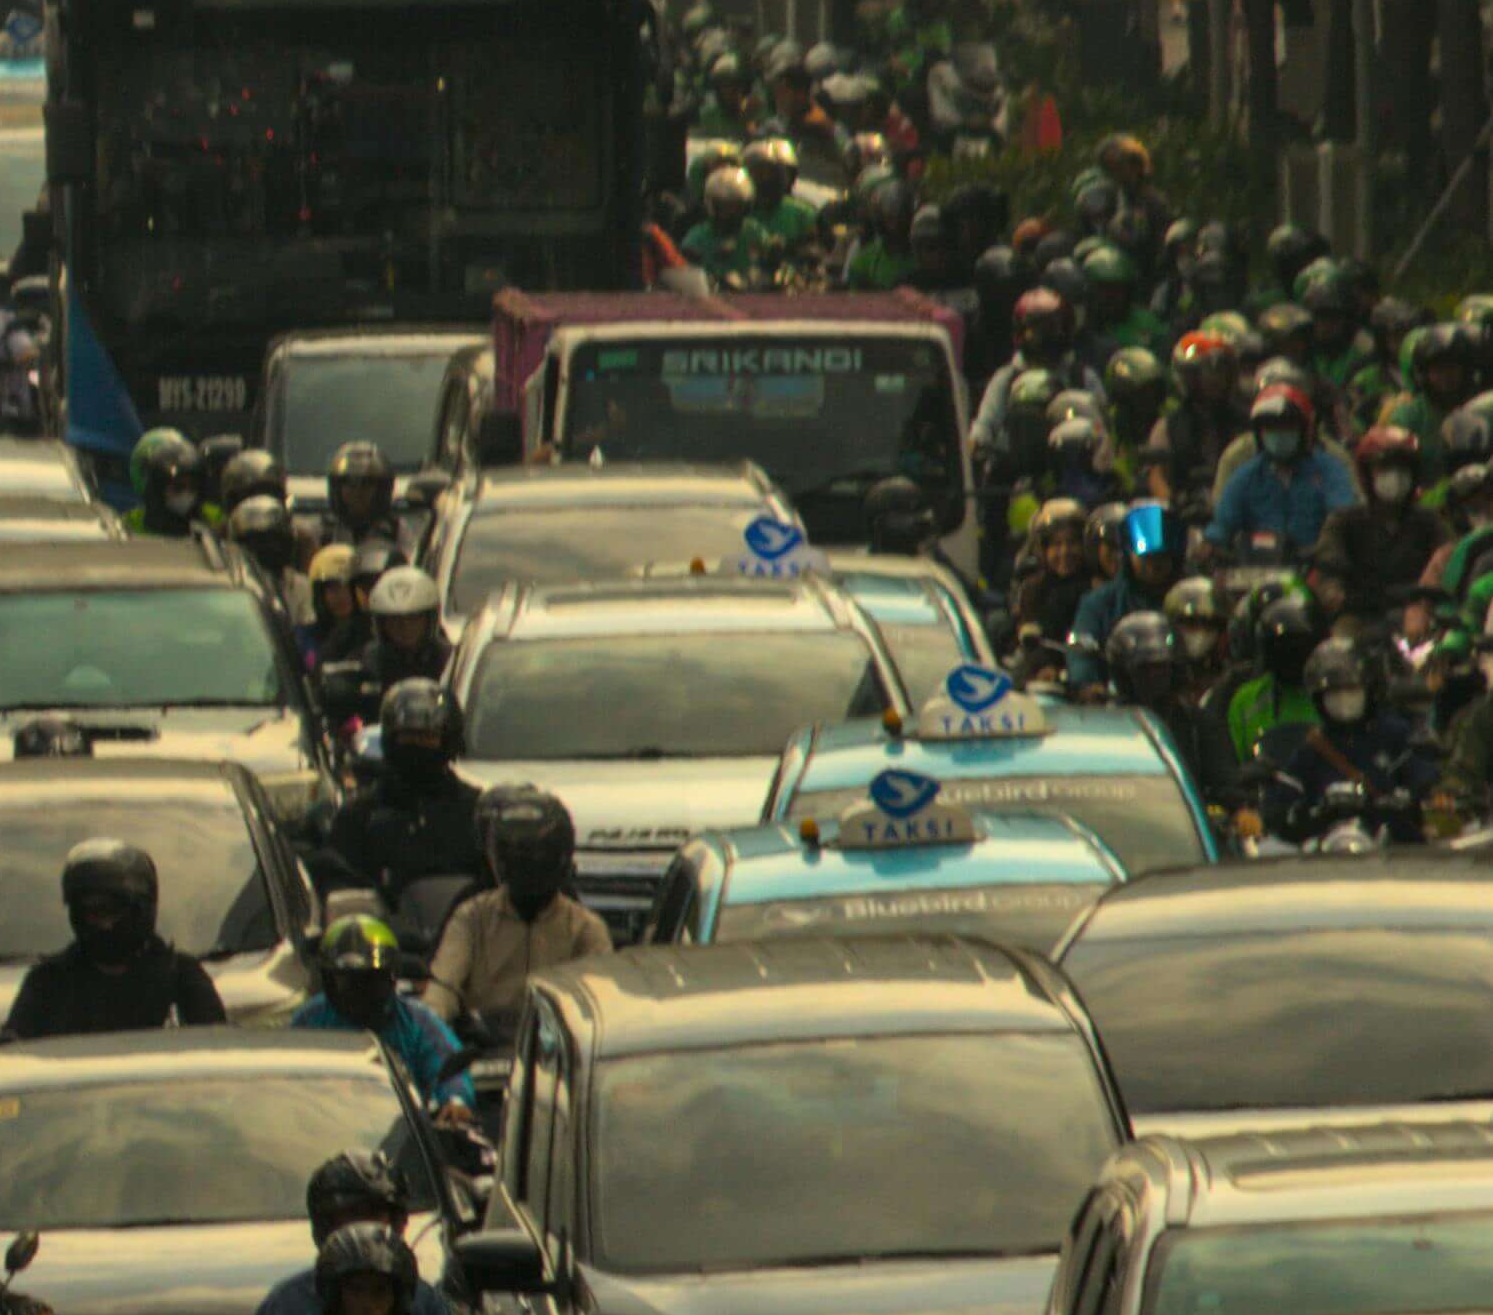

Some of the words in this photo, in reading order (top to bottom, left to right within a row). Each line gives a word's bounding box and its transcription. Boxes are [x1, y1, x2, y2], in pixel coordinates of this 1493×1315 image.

[940, 714, 1026, 734] TAKSI
[861, 821, 955, 840] TAKSI
[842, 889, 989, 921] Bluebird
